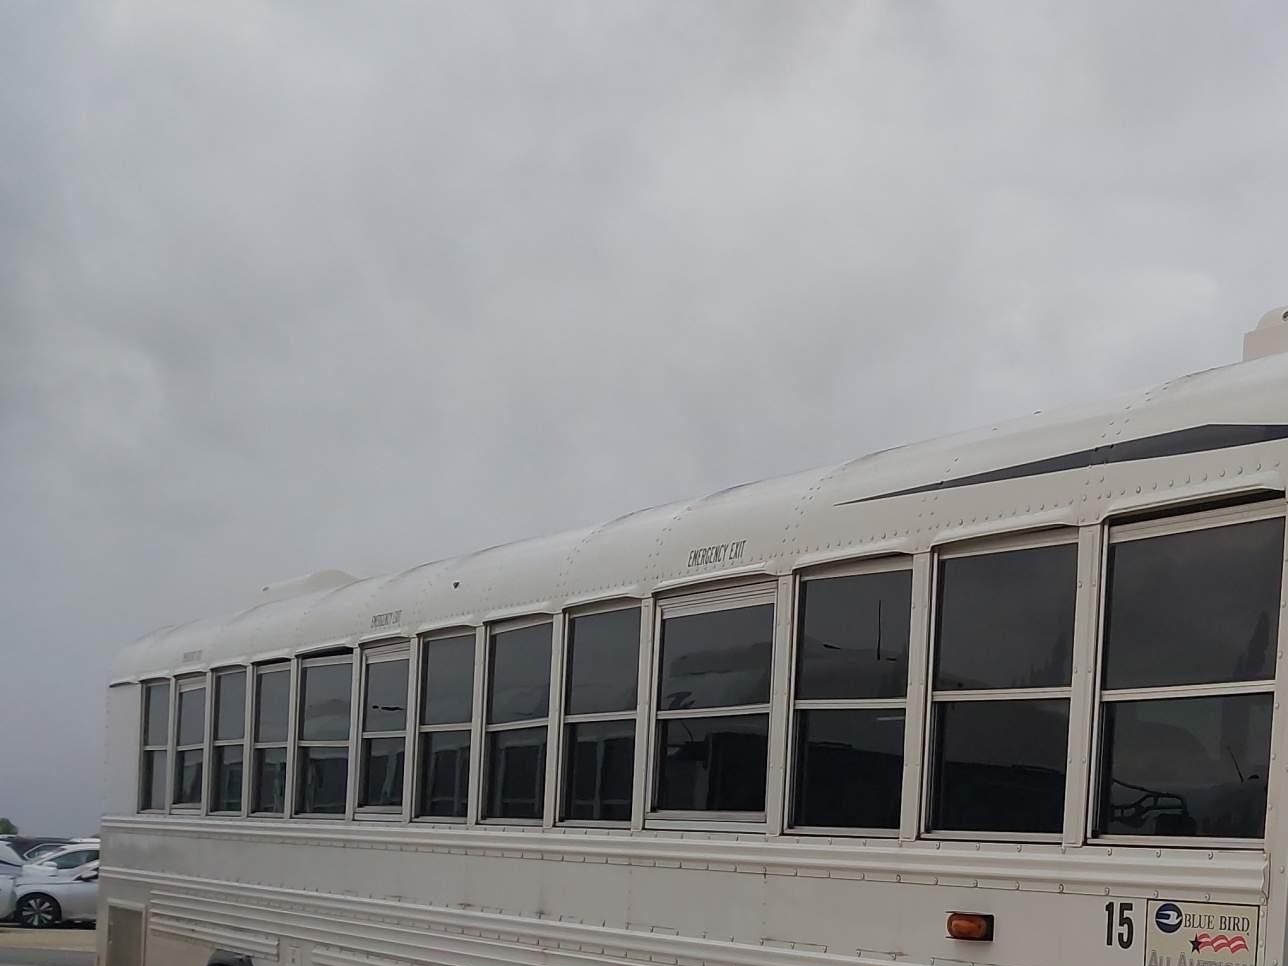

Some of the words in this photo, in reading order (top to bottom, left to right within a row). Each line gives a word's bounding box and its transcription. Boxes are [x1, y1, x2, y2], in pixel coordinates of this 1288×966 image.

[687, 543, 729, 568] EMERGENCY
[728, 540, 747, 560] EXIT
[1105, 901, 1134, 949] 15
[1184, 913, 1215, 930] BLUE
[1219, 915, 1250, 932] BIRD
